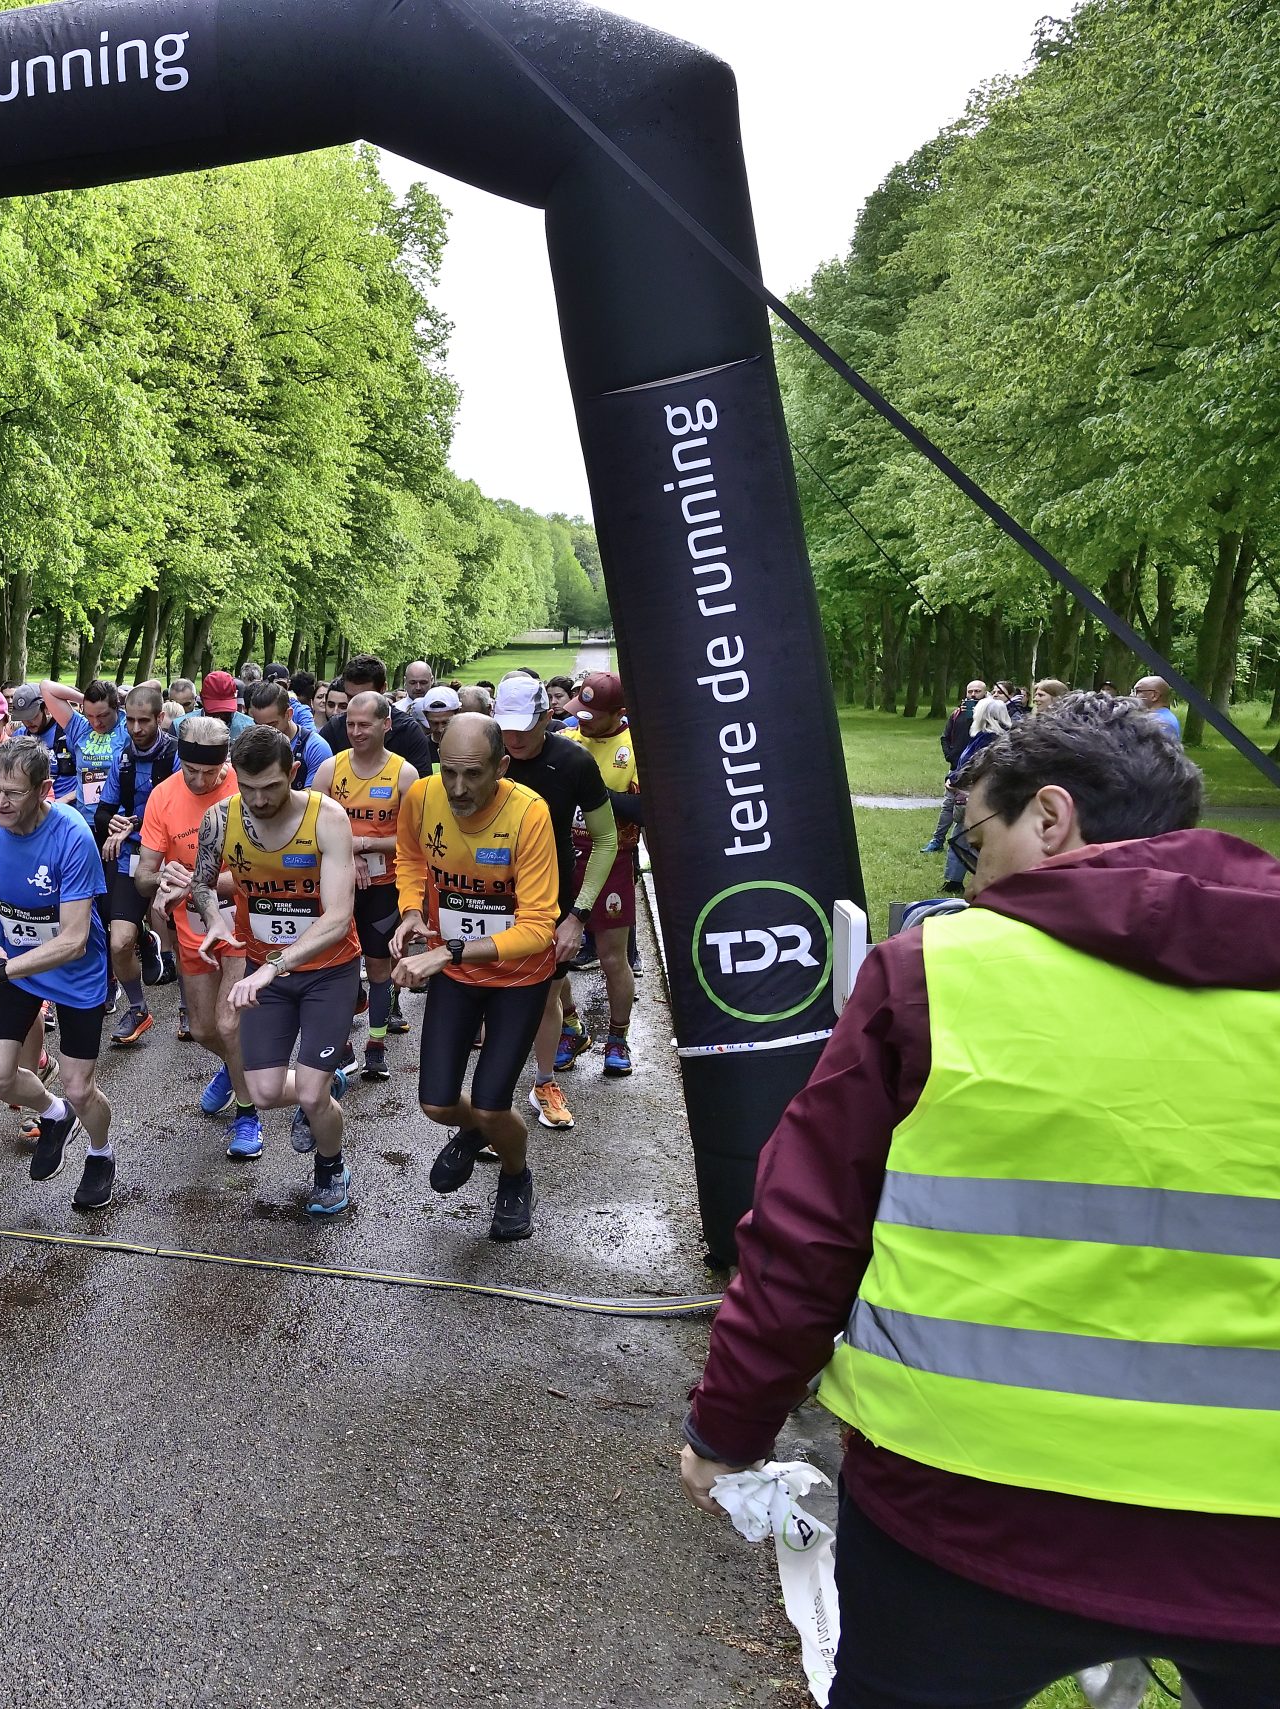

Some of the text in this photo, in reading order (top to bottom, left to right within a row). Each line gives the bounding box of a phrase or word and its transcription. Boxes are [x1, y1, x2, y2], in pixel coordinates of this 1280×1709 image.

[663, 397, 772, 857] terre de running
[378, 808, 393, 822] 91
[449, 897, 463, 906] TDR
[1, 905, 31, 916] TDR TERRE
[12, 923, 37, 937] 45
[271, 920, 297, 935] 53
[460, 918, 486, 935] 51
[705, 924, 820, 974] TDR
